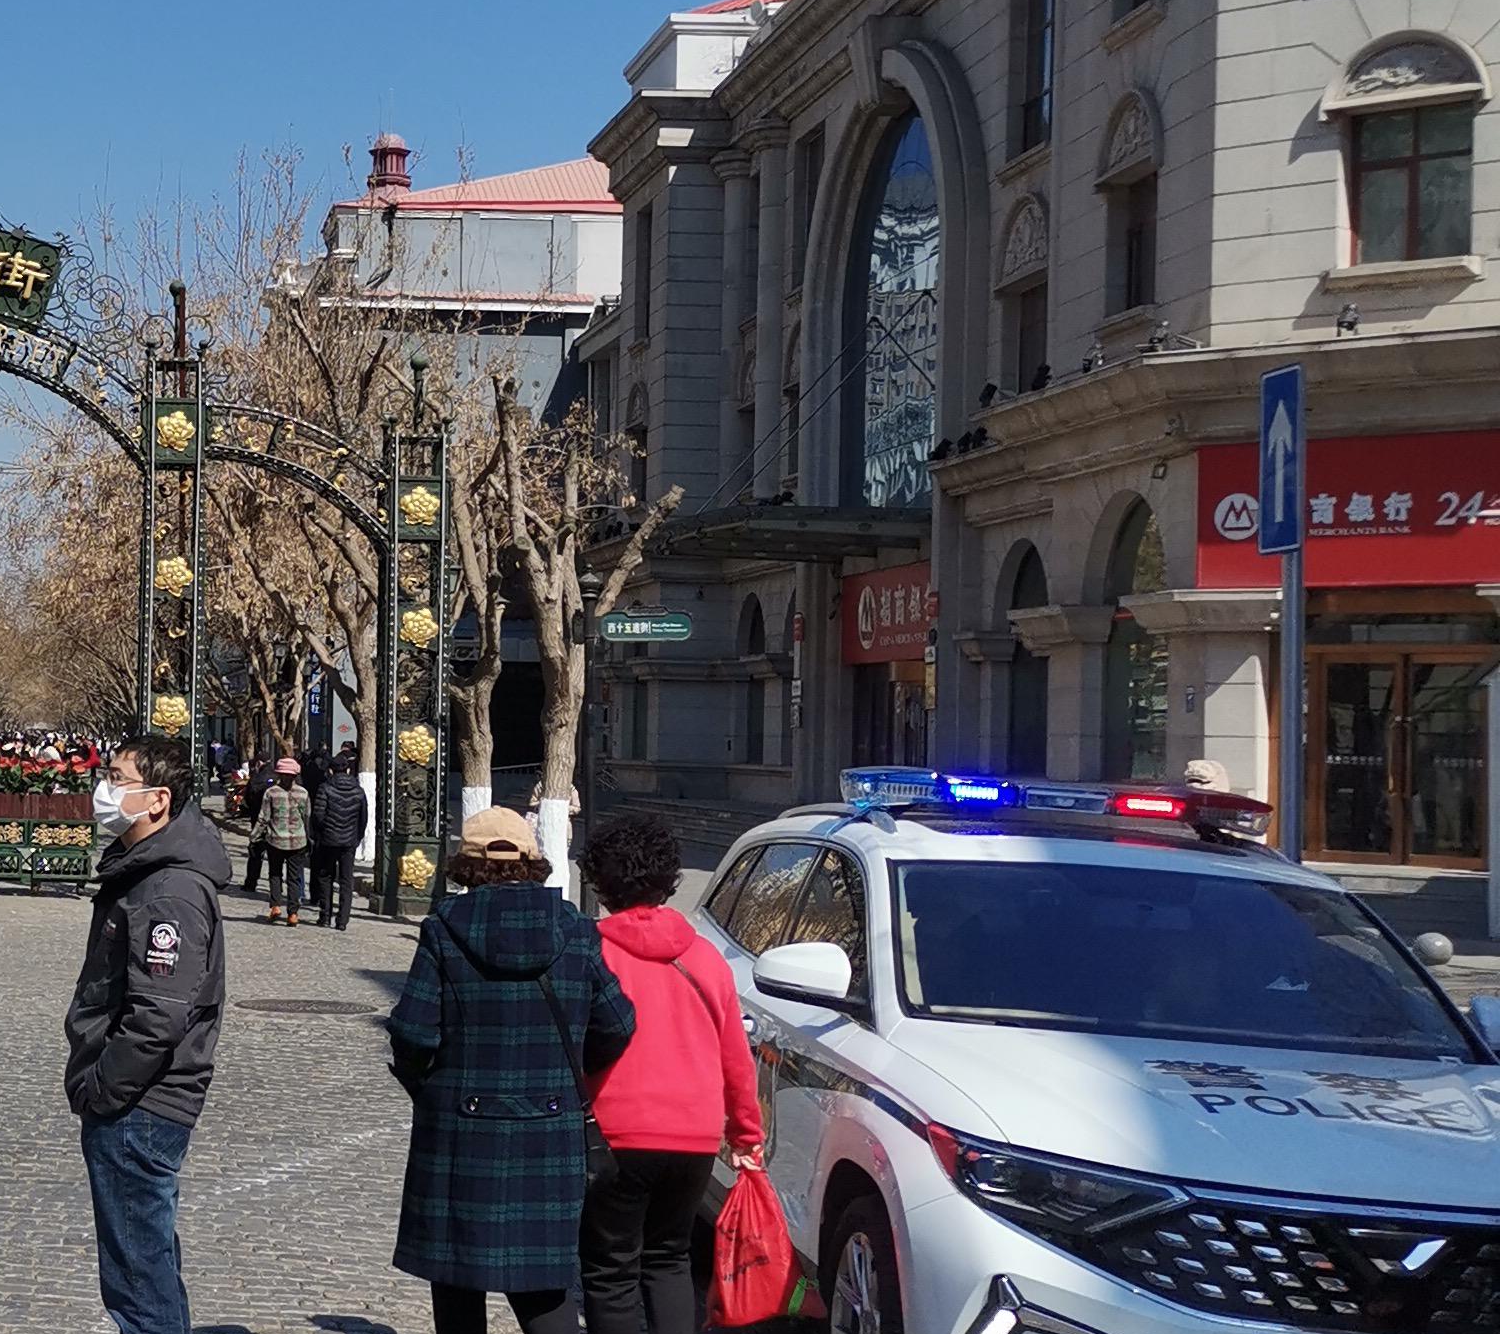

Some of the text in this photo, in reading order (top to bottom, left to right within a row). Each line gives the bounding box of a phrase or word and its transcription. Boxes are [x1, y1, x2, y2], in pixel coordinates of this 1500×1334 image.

[1308, 491, 1413, 525] 商银行
[1190, 1093, 1472, 1134] POLICE
